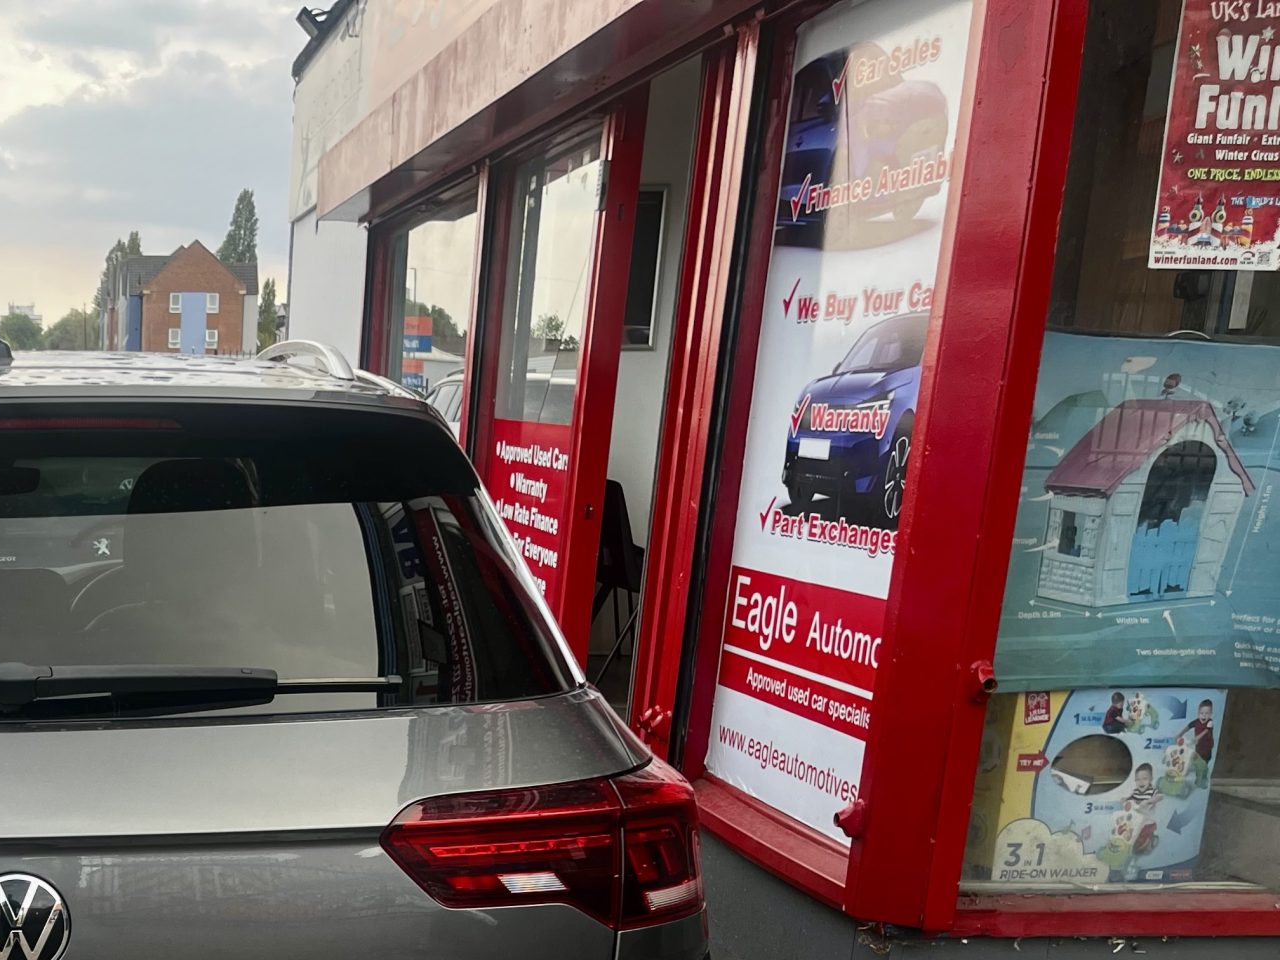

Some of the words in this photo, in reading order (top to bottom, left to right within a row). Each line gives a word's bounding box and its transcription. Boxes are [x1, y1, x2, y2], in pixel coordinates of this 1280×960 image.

[1211, 1, 1251, 21] UK's
[854, 56, 884, 88] Car
[888, 36, 942, 76] Sales
[1187, 133, 1213, 144] Giant
[1216, 133, 1250, 145] Funfair
[1215, 149, 1248, 161] Winter
[1251, 150, 1279, 161] Circus
[1187, 168, 1208, 179] ONE
[806, 177, 873, 214] Finance
[1154, 255, 1238, 266] winterfunland.com
[797, 297, 820, 323] We
[824, 294, 856, 325] Buy
[862, 288, 904, 317] Your
[811, 403, 890, 440] Warranty
[500, 440, 533, 465] Approved
[533, 445, 551, 467] Used
[515, 472, 547, 503] Warranty
[500, 498, 514, 521] Low
[514, 502, 529, 526] Rate
[529, 506, 558, 535] Finance
[771, 508, 805, 539] Part
[524, 537, 558, 568] Everyone
[732, 574, 798, 651] Eagle
[1116, 616, 1139, 625] Width
[746, 667, 787, 698] Approved
[787, 683, 810, 706] used
[811, 693, 827, 712] car
[1144, 738, 1152, 750] 2
[1084, 802, 1093, 814] 3
[1004, 843, 1022, 867] 3
[1023, 859, 1032, 867] IN
[1035, 843, 1045, 867] 1
[999, 868, 1047, 880] RIDE-ON
[1050, 867, 1097, 879] WALKER
